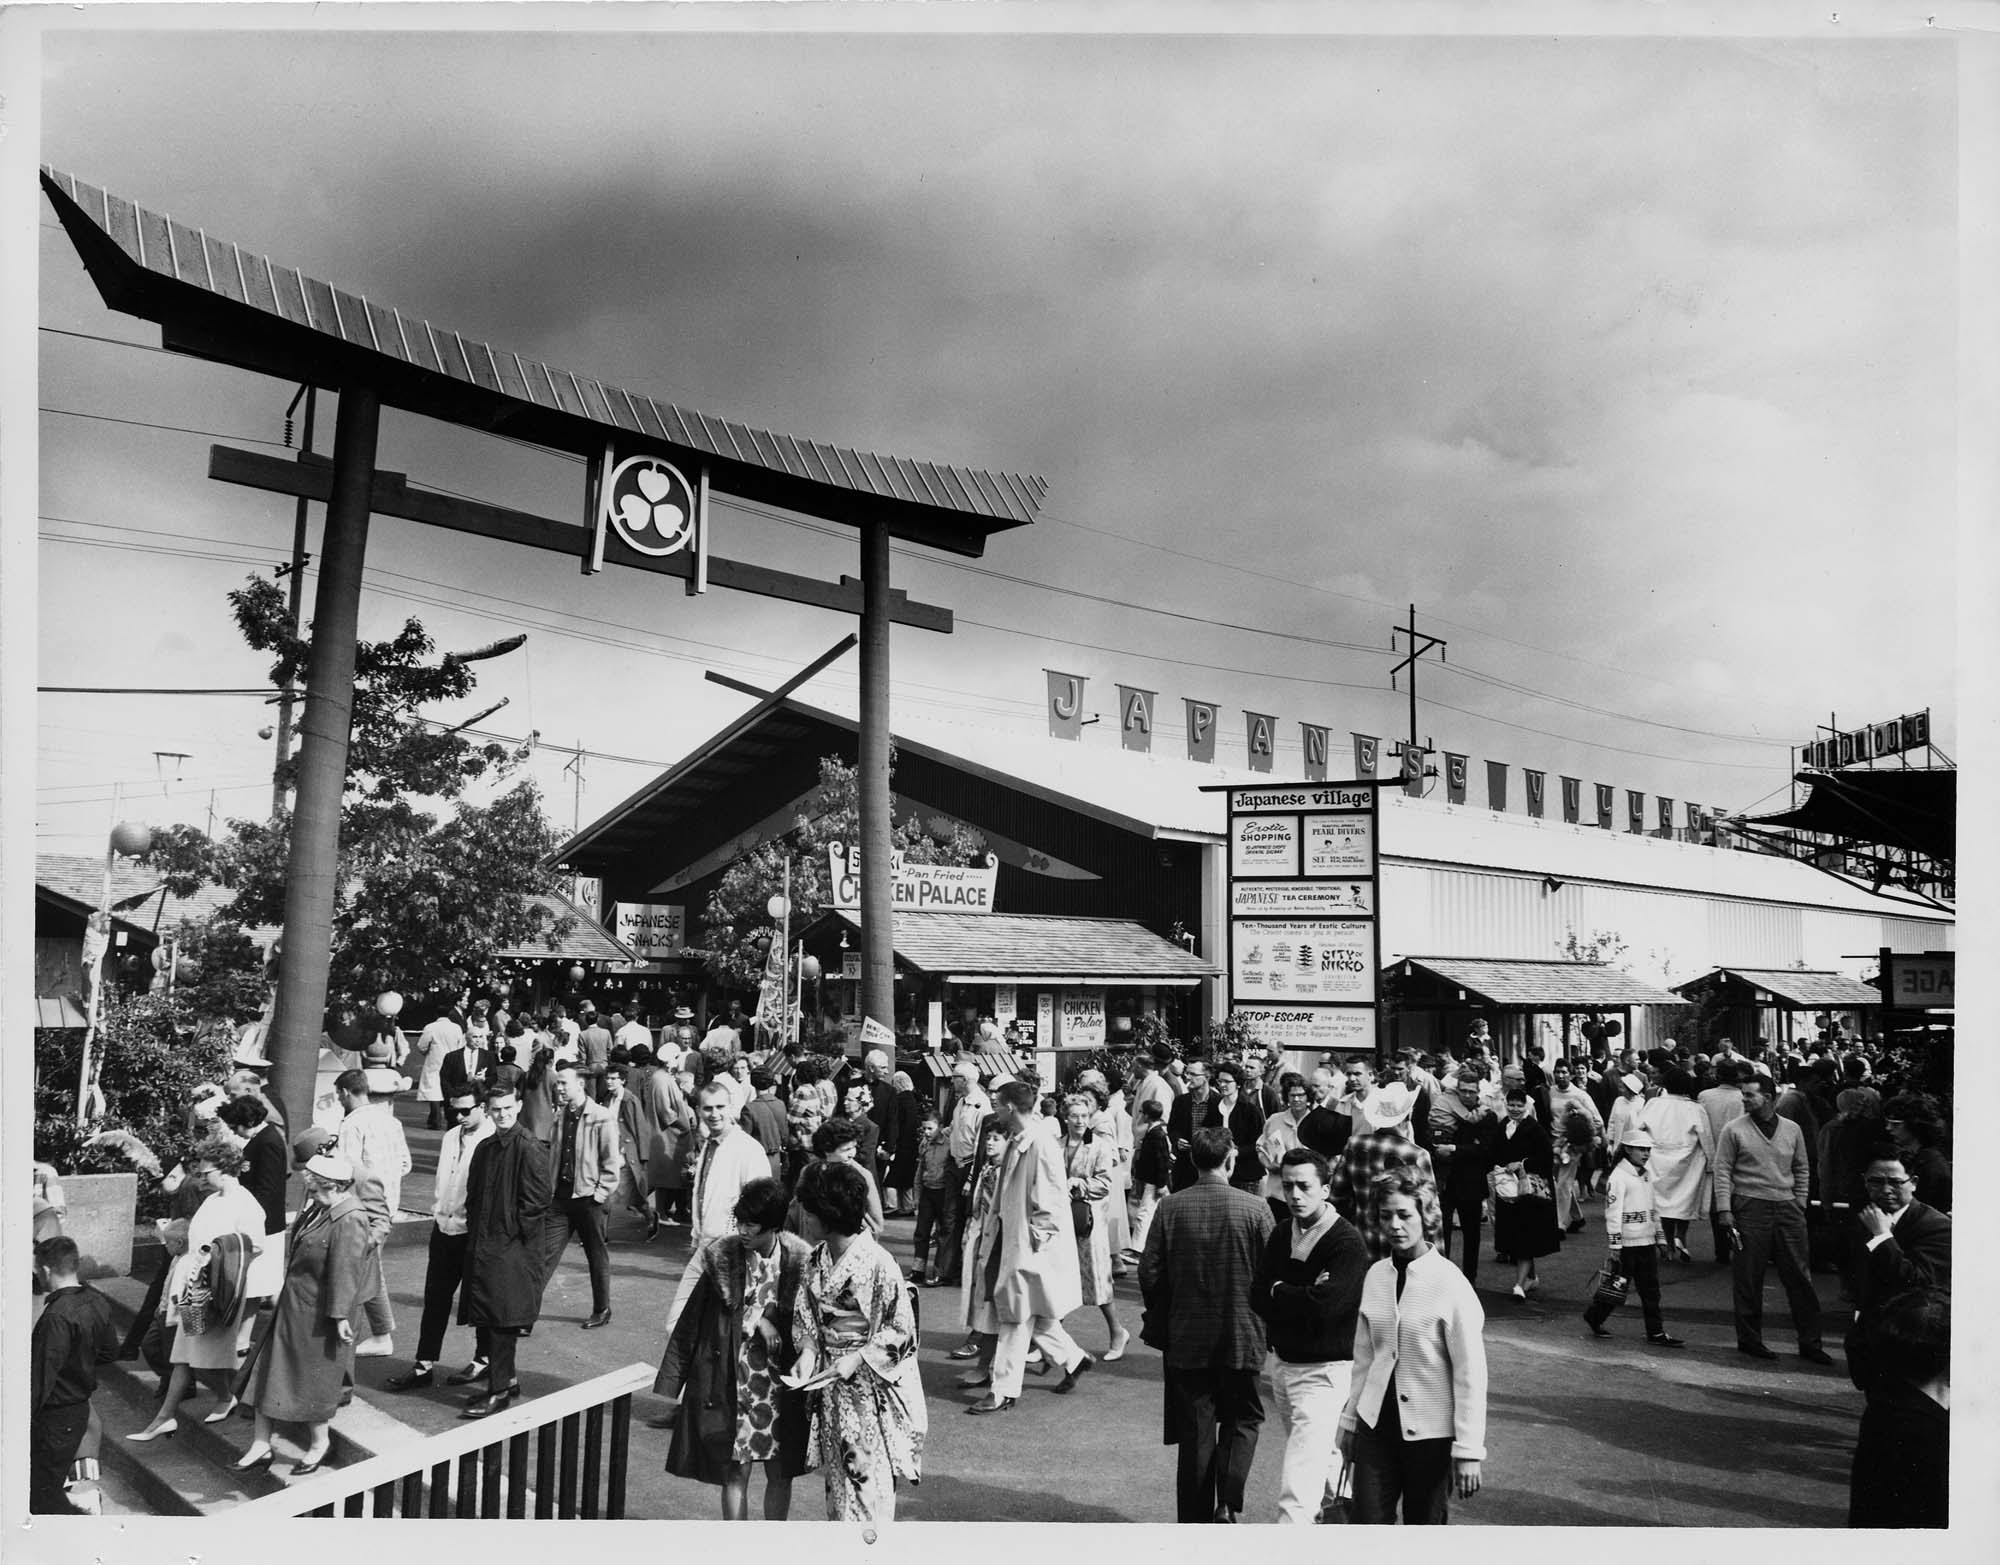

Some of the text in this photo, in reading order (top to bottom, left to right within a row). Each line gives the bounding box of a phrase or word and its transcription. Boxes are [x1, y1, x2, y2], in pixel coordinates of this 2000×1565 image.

[1053, 679, 1466, 788] JAPANESE
[1235, 790, 1372, 810] Japanese village
[1243, 821, 1288, 834] Exotic
[1312, 827, 1366, 836] PEARL DIVERS
[1240, 833, 1292, 842] SHOPPING
[906, 867, 965, 881] Pan Fried
[838, 875, 987, 907] CHEN PALACE
[1235, 893, 1280, 904] JAPANESE
[619, 914, 680, 929] JAPANESE
[626, 932, 674, 948] SNACKS
[1321, 949, 1355, 961] CITY
[1320, 960, 1365, 973] NIKKO
[1063, 1000, 1101, 1016] CHICKEN
[1242, 1010, 1315, 1022] STOP-ESCAPE
[1071, 1016, 1104, 1031] Palace
